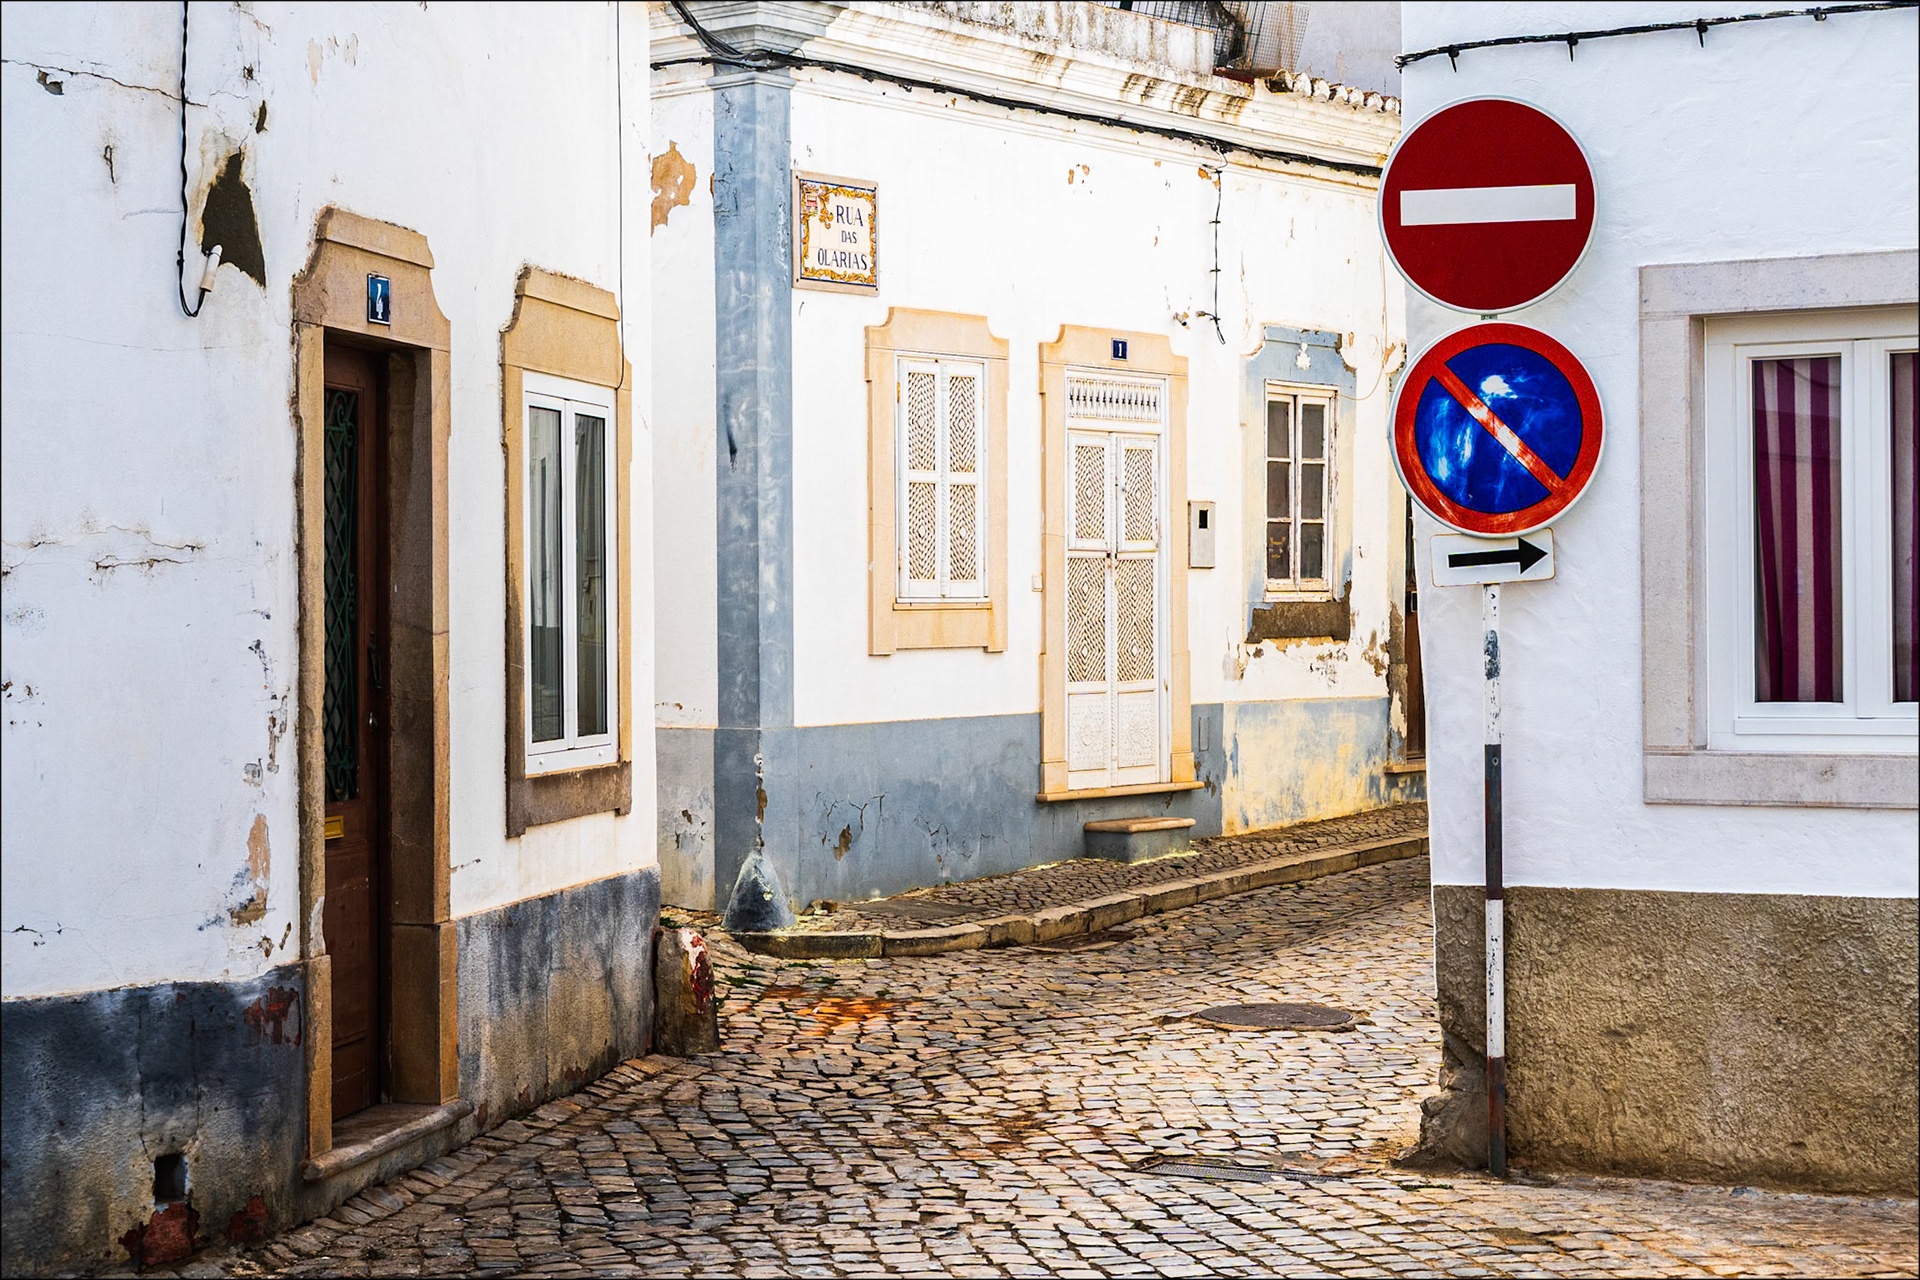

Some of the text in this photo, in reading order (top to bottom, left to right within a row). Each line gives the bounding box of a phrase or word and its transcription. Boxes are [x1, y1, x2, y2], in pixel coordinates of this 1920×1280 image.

[836, 205, 864, 227] RUA
[841, 230, 858, 244] DAS
[817, 248, 868, 271] OLARIAS
[1118, 343, 1122, 357] 1
